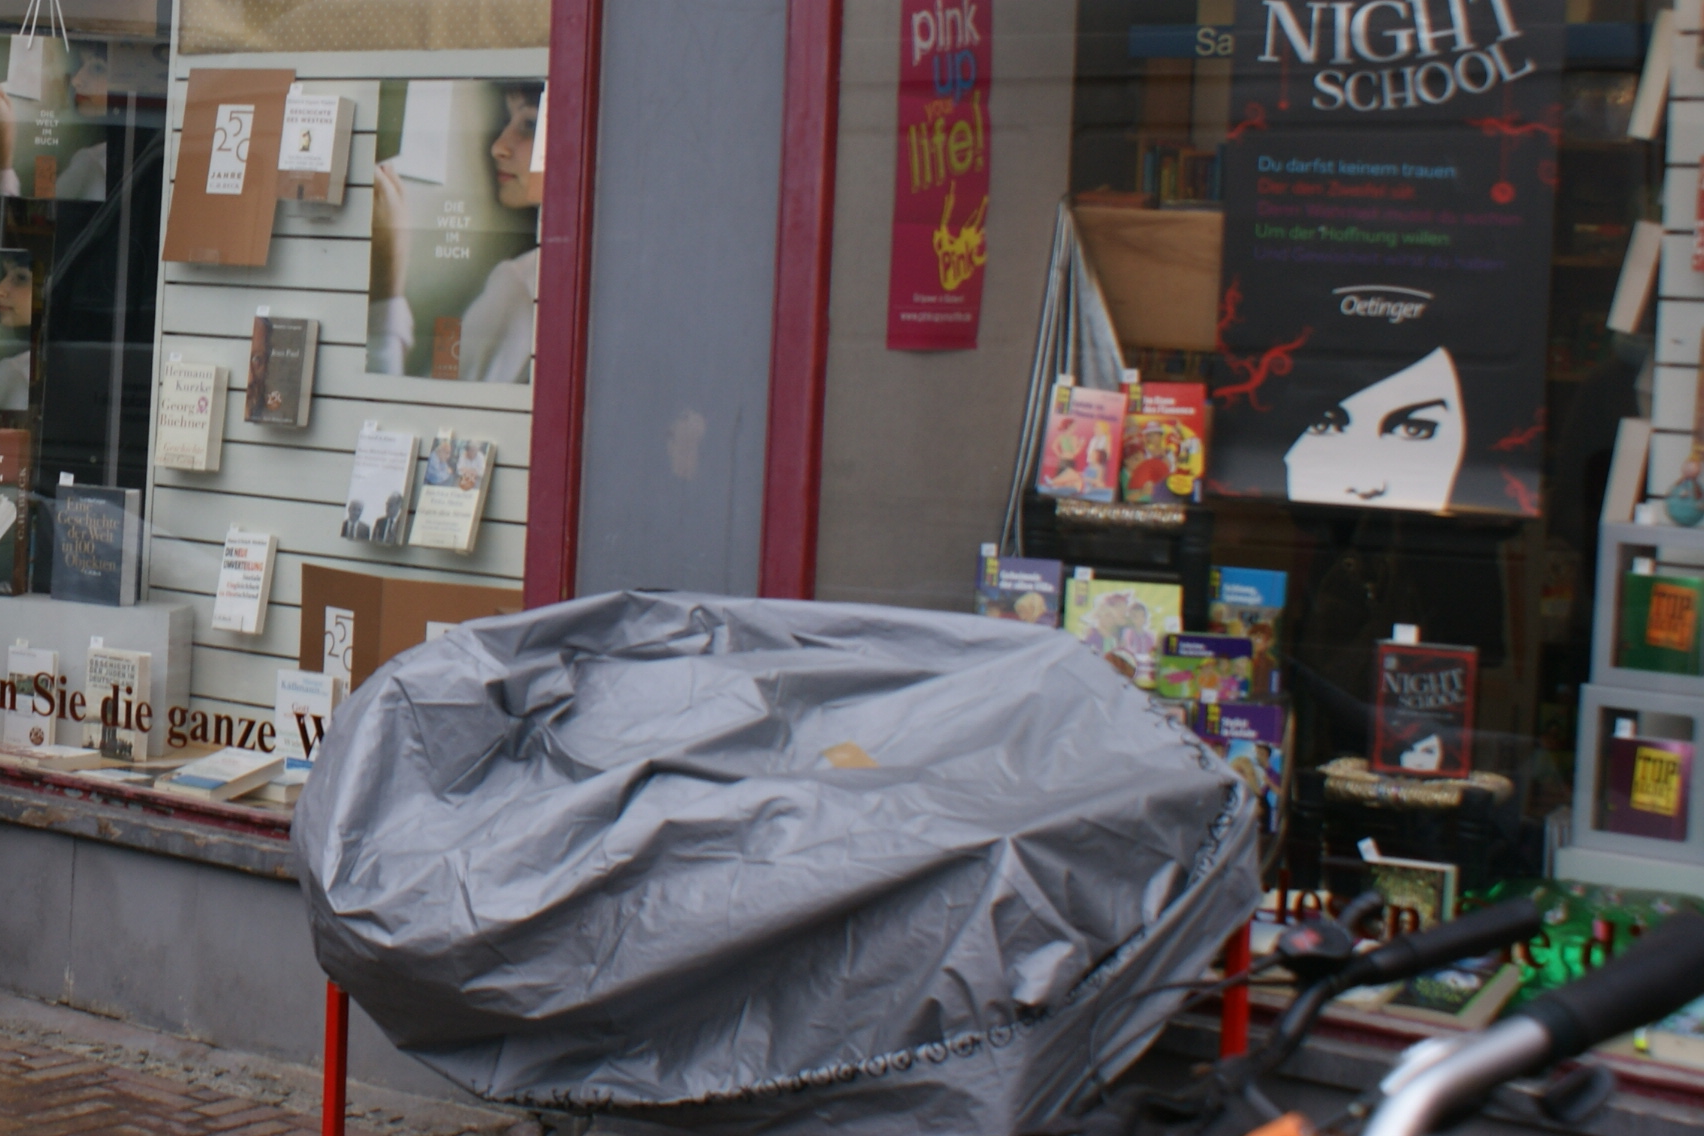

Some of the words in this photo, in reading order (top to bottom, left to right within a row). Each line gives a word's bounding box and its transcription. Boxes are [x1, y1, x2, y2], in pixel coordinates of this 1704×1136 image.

[1196, 27, 1235, 56] Sa
[932, 49, 977, 107] up
[1312, 41, 1536, 112] SCHOOL
[40, 110, 55, 118] DIE
[35, 119, 60, 127] WELT
[42, 128, 52, 136] IM
[34, 137, 59, 146] BUCH
[907, 89, 984, 194] life!
[210, 171, 243, 180] JAHRE
[1257, 156, 1283, 172] Du
[1286, 158, 1335, 174] darfst
[1338, 160, 1398, 176] keinem
[1402, 163, 1458, 179] trauen
[443, 200, 465, 214] DIE
[436, 216, 472, 229] WELT
[445, 231, 460, 243] IM
[1255, 224, 1285, 239] Um
[1289, 225, 1315, 240] der
[1322, 226, 1398, 248] Hoffnung
[1402, 229, 1452, 246] willen
[435, 246, 470, 259] BUCH
[1340, 295, 1426, 324] Oetinger
[164, 366, 213, 380] Hermann
[175, 380, 212, 393] Kurzke
[161, 399, 195, 414] Georg
[159, 414, 207, 430] Büchner
[66, 496, 90, 511] Eine
[57, 510, 119, 529] Geschichte
[67, 525, 86, 539] der
[87, 526, 114, 543] Welt
[75, 539, 95, 554] 100
[64, 552, 116, 574] Objekten
[1382, 668, 1464, 695] NIGHT
[1398, 691, 1467, 709] SCHOOL
[32, 672, 87, 723] Sie
[100, 683, 153, 733] die
[166, 704, 276, 754] ganze
[291, 712, 326, 760] W
[1638, 755, 1678, 789] TOP
